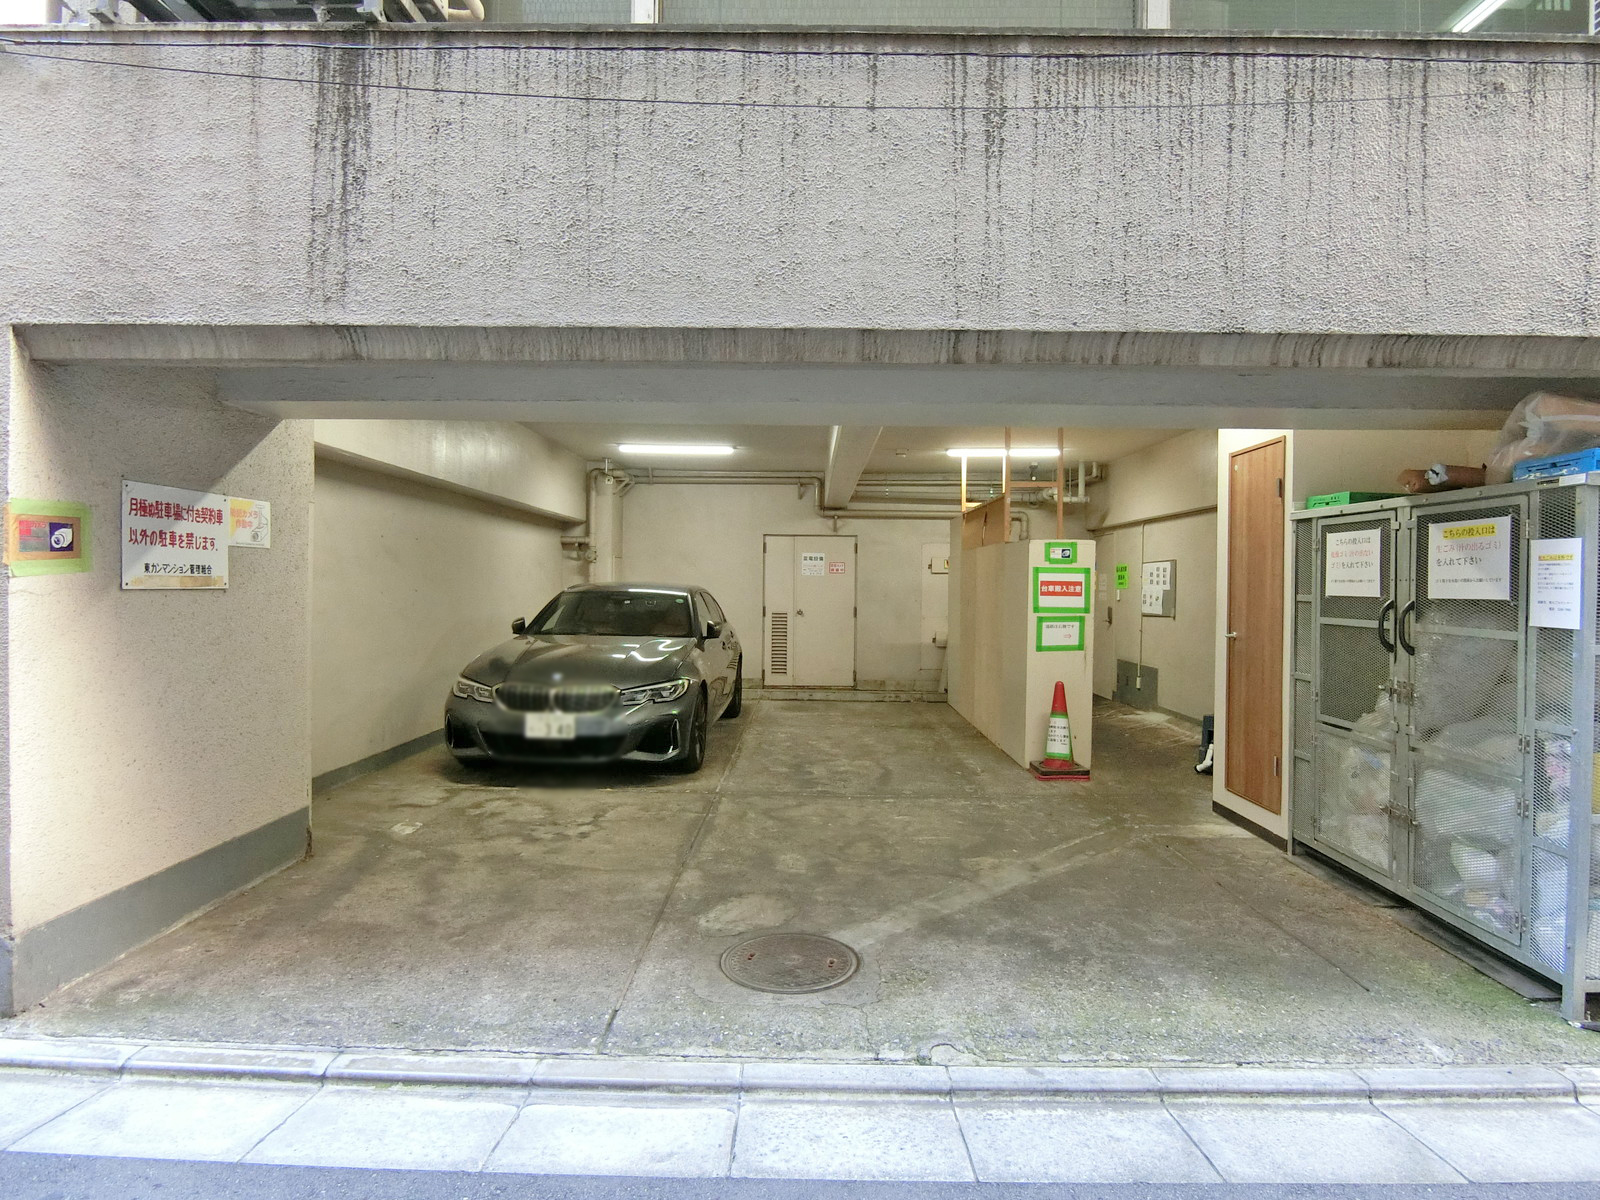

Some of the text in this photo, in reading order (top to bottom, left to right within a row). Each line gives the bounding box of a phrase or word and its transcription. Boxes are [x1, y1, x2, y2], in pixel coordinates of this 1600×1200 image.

[128, 497, 224, 526] 月極め駐車場に付き契約車
[1443, 525, 1496, 539] こちらの投入口は
[1436, 556, 1482, 567] を入れて下さい
